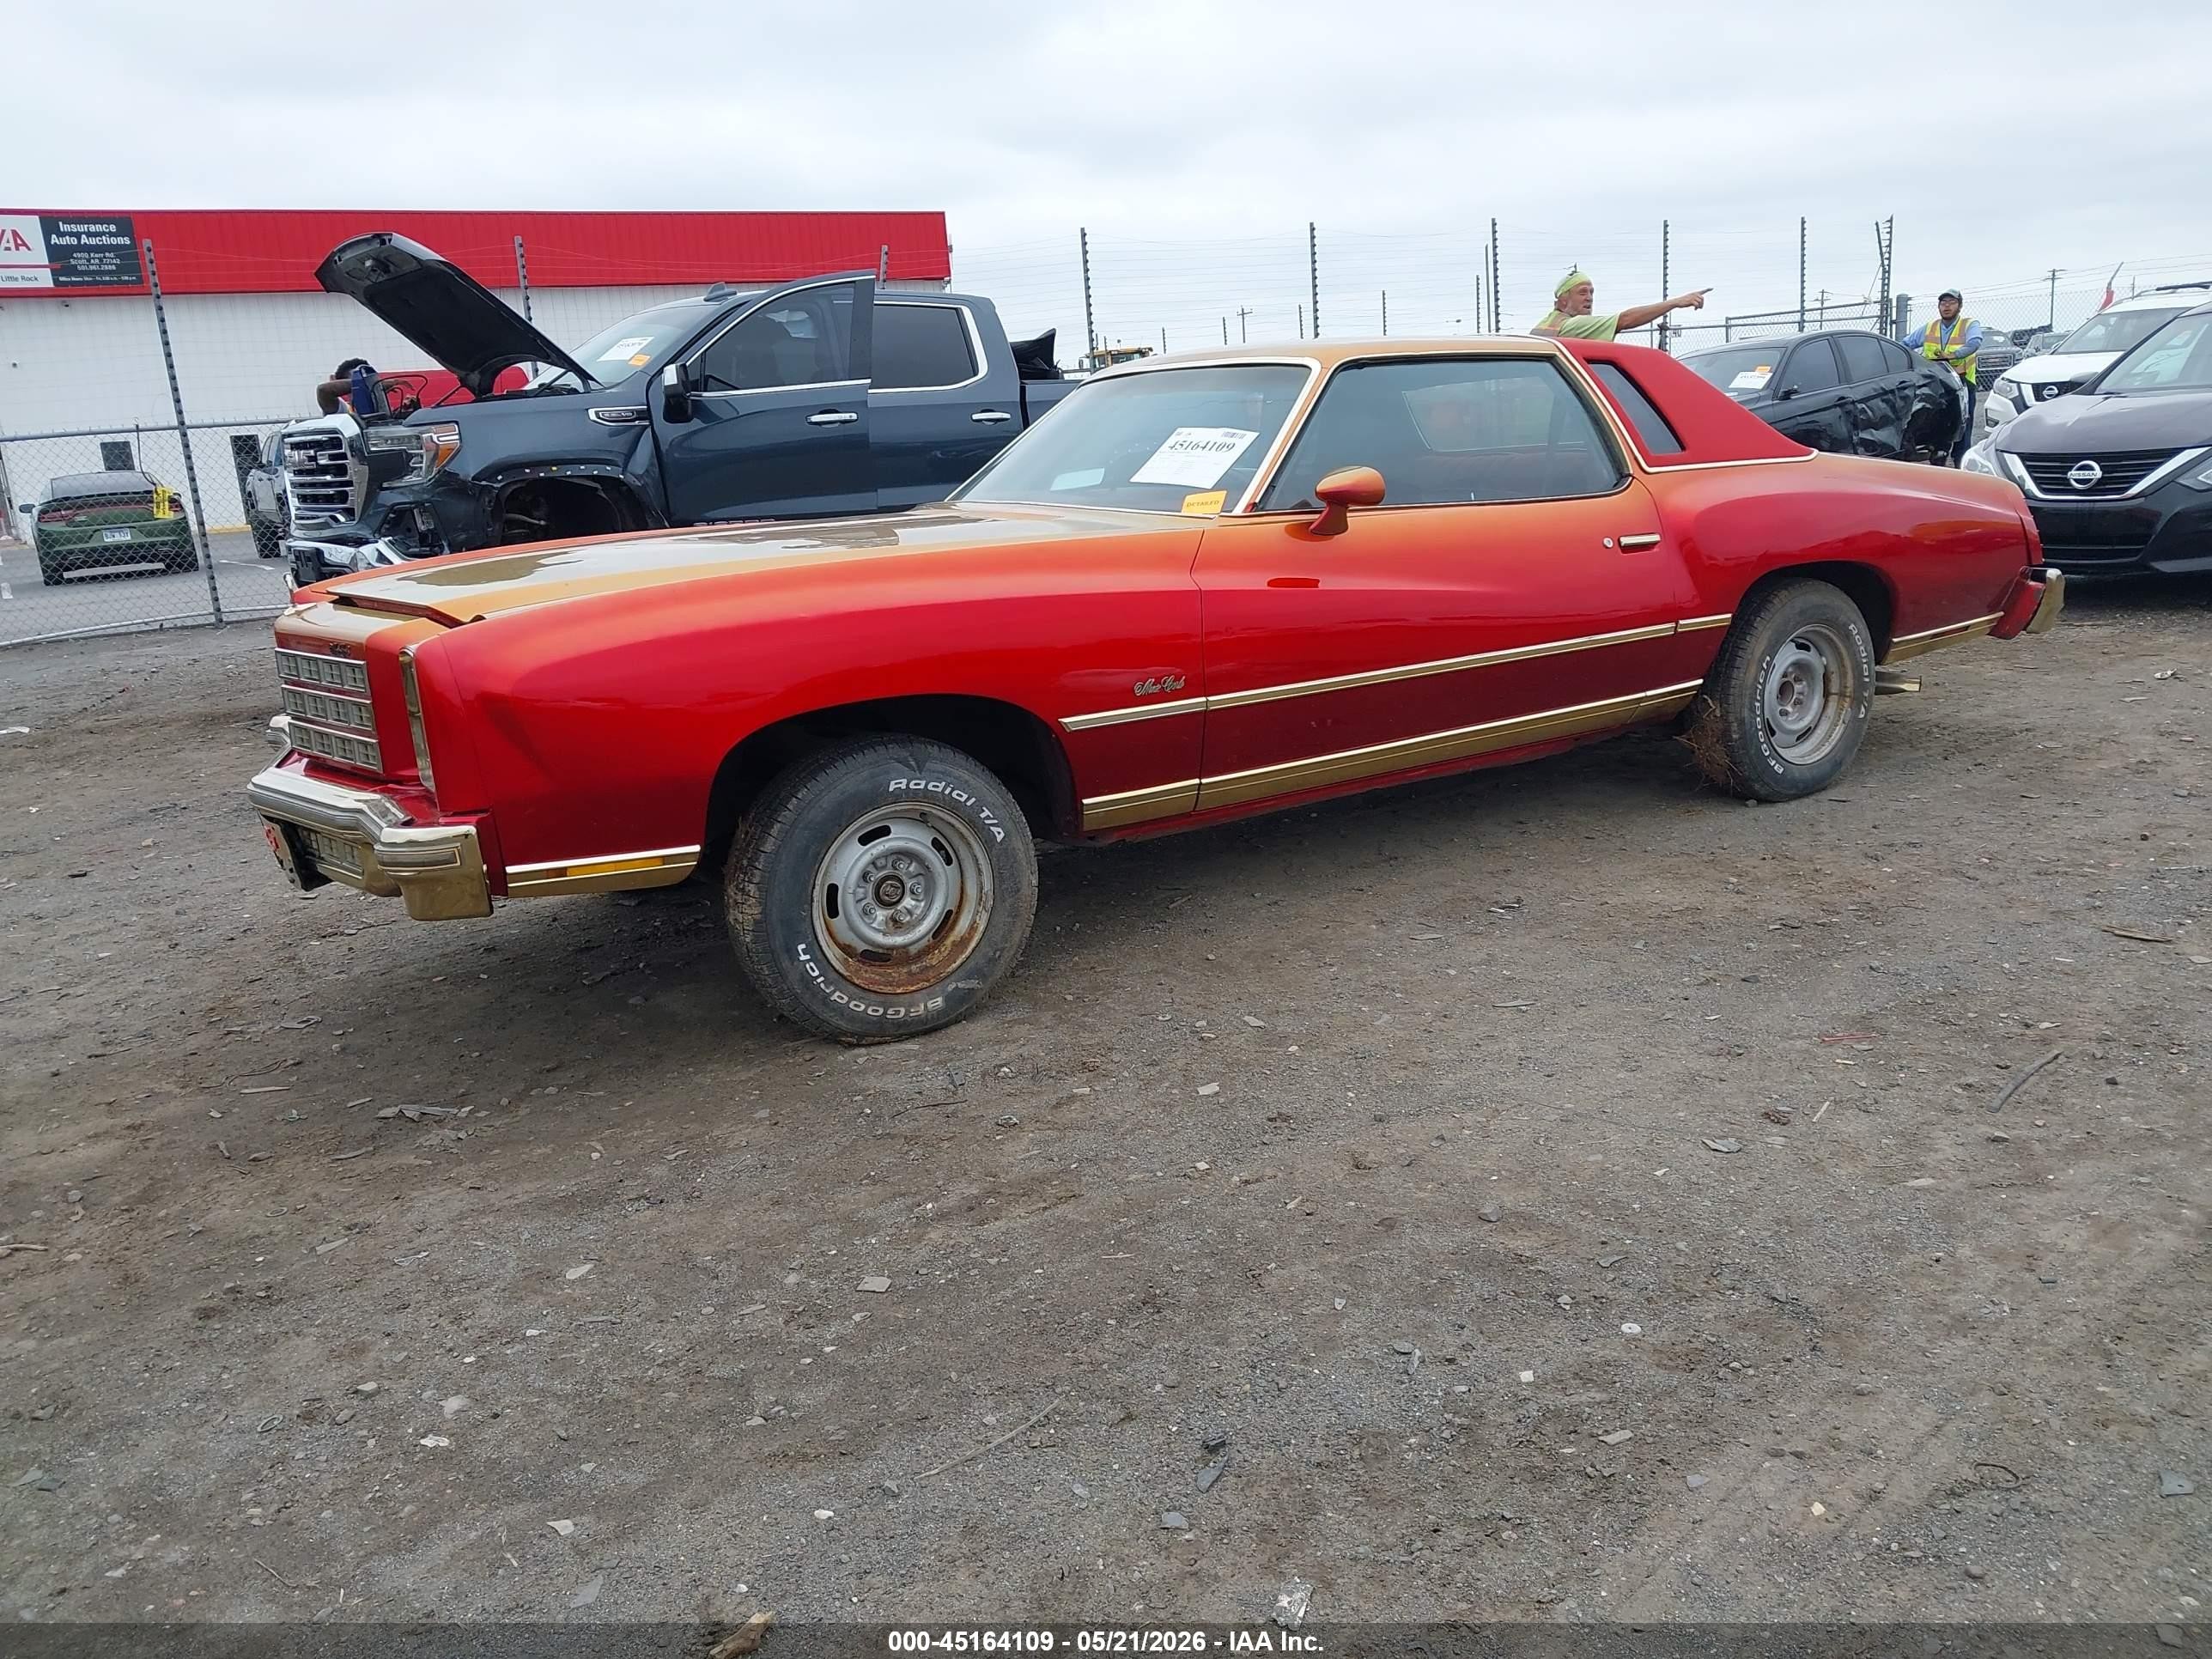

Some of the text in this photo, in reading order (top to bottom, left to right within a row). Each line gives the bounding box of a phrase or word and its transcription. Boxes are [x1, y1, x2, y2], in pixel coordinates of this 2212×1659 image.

[51, 234, 131, 246] Auto Auctions
[59, 222, 117, 233] Insurance
[1168, 440, 1236, 453] 45164109
[1848, 623, 1870, 683] Radial
[1754, 656, 1785, 775] BFGoodrich
[888, 778, 1006, 843] Radial T/A
[796, 943, 944, 1020] BFGoodrich
